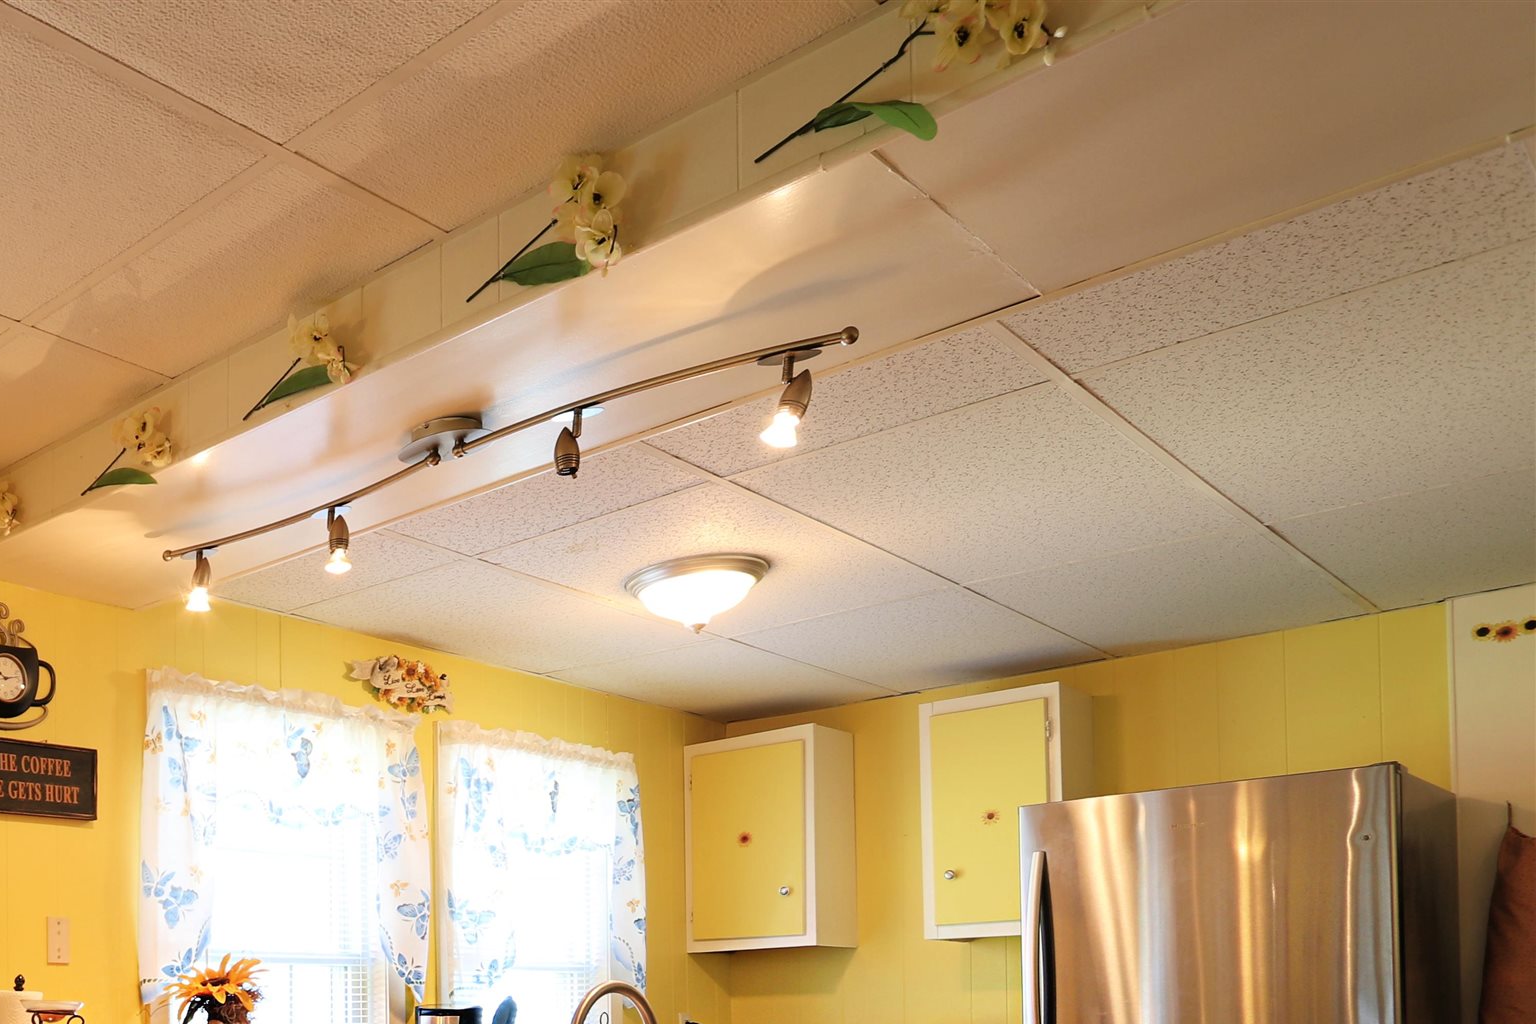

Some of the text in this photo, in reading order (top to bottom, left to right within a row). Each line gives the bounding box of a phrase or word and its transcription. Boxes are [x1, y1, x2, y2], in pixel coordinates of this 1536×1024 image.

[21, 755, 72, 778] COFFEE
[8, 780, 42, 801] GETS
[45, 783, 80, 804] HURT
